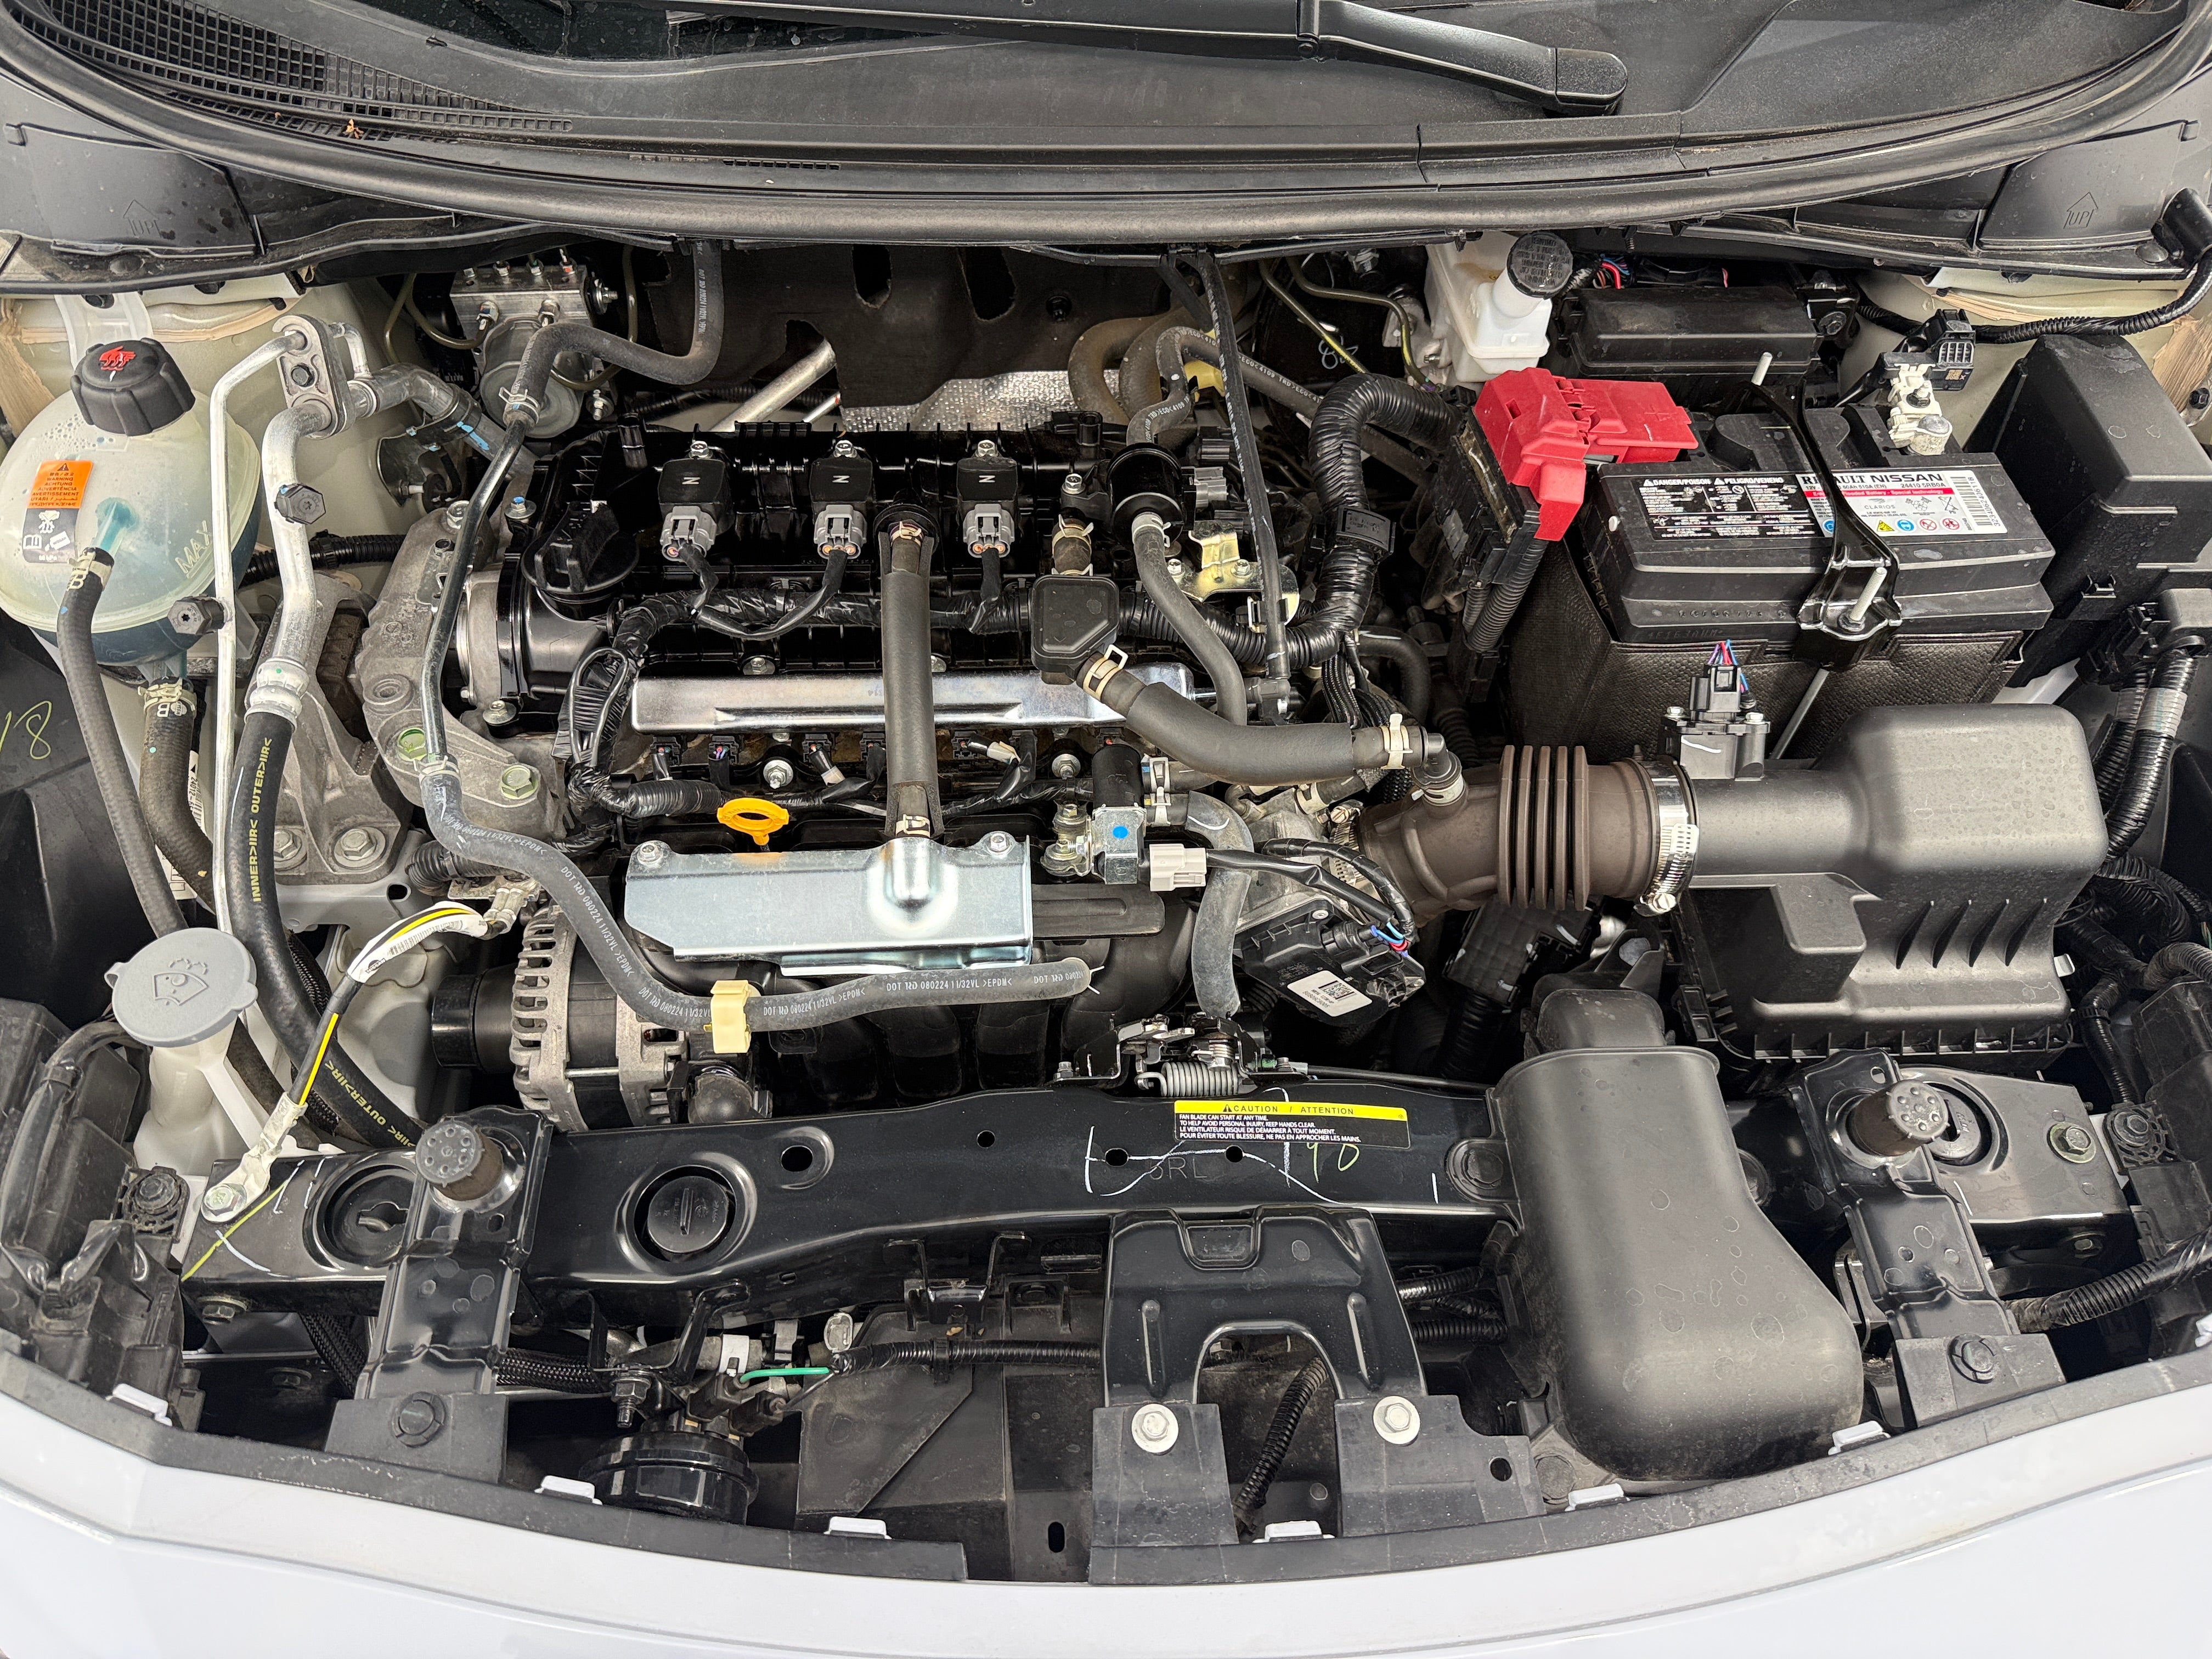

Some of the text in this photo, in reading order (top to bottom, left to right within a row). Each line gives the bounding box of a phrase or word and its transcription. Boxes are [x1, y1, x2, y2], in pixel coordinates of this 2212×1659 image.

[2069, 211, 2090, 225] UP
[1869, 473, 1943, 483] NISSAN
[174, 520, 212, 575] MAX
[249, 737, 272, 903] INNER>IIR< OUTER>IIR<
[561, 866, 577, 882] DOT
[582, 895, 603, 924] 080224
[365, 957, 386, 974] NISSAN
[886, 982, 901, 992] DOT
[920, 980, 949, 990] 080224
[983, 978, 1012, 988] >EPDM<
[1034, 975, 1048, 984] DOT
[638, 987, 652, 1000] DOT
[659, 1001, 684, 1017] 080224
[763, 1006, 776, 1016] DOT
[790, 1001, 812, 1014] 080224
[1301, 1106, 1354, 1114] ATTENTION
